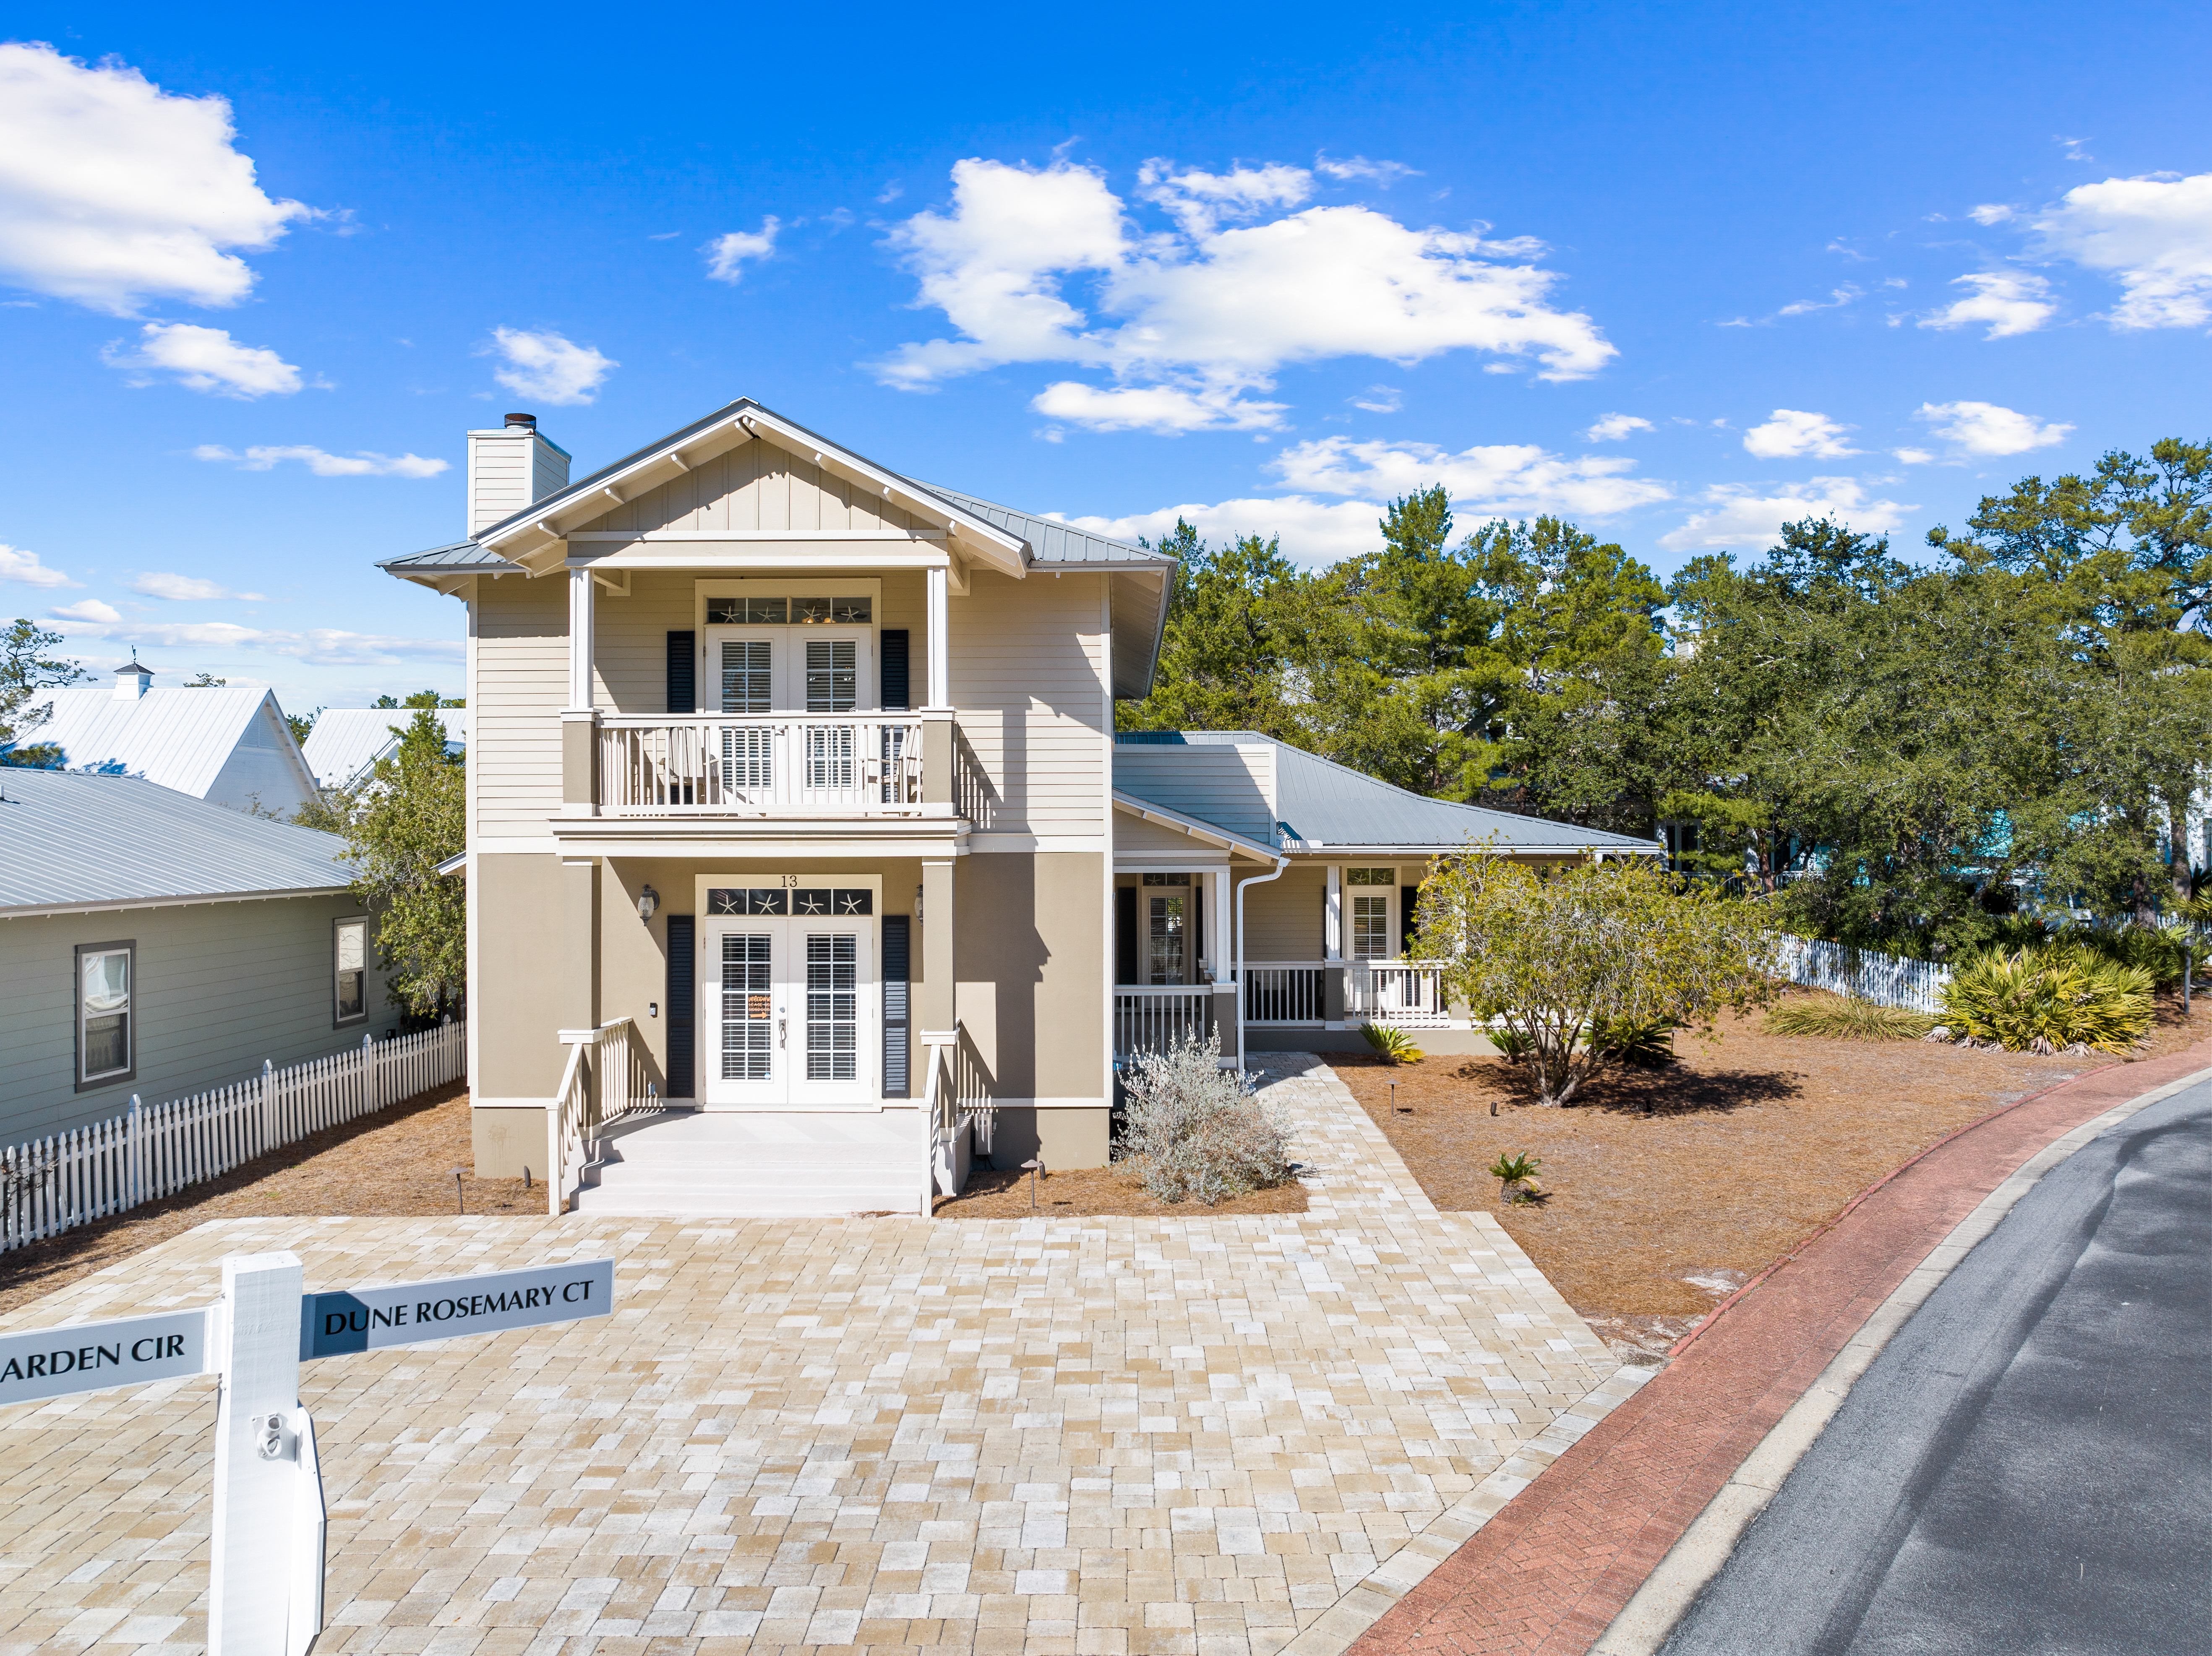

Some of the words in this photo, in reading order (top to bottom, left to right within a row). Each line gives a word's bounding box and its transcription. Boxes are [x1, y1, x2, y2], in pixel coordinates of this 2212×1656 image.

[781, 875, 797, 888] 13
[325, 1304, 408, 1336] DUNE
[416, 1285, 556, 1323] ROSEMARY
[563, 1280, 594, 1302] CT
[131, 1335, 185, 1362] CIR
